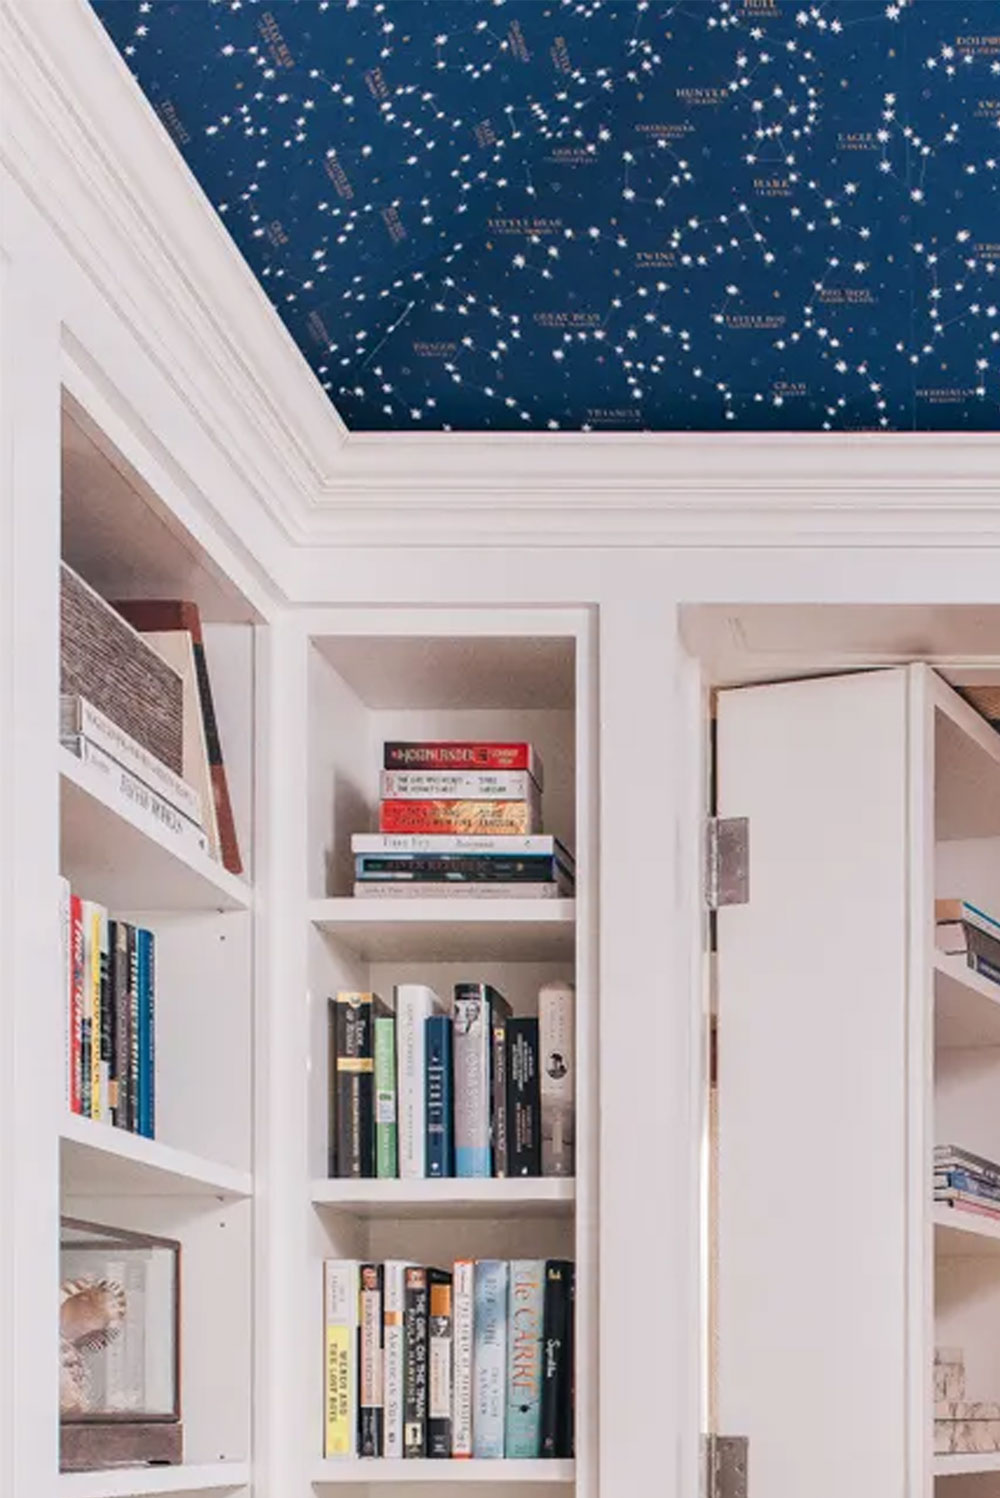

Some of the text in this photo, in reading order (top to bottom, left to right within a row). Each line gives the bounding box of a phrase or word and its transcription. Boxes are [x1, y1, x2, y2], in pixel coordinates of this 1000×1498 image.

[407, 1308, 415, 1404] PAULA HAWKINS
[416, 1293, 426, 1418] THE GIRL ON THE TRAIN
